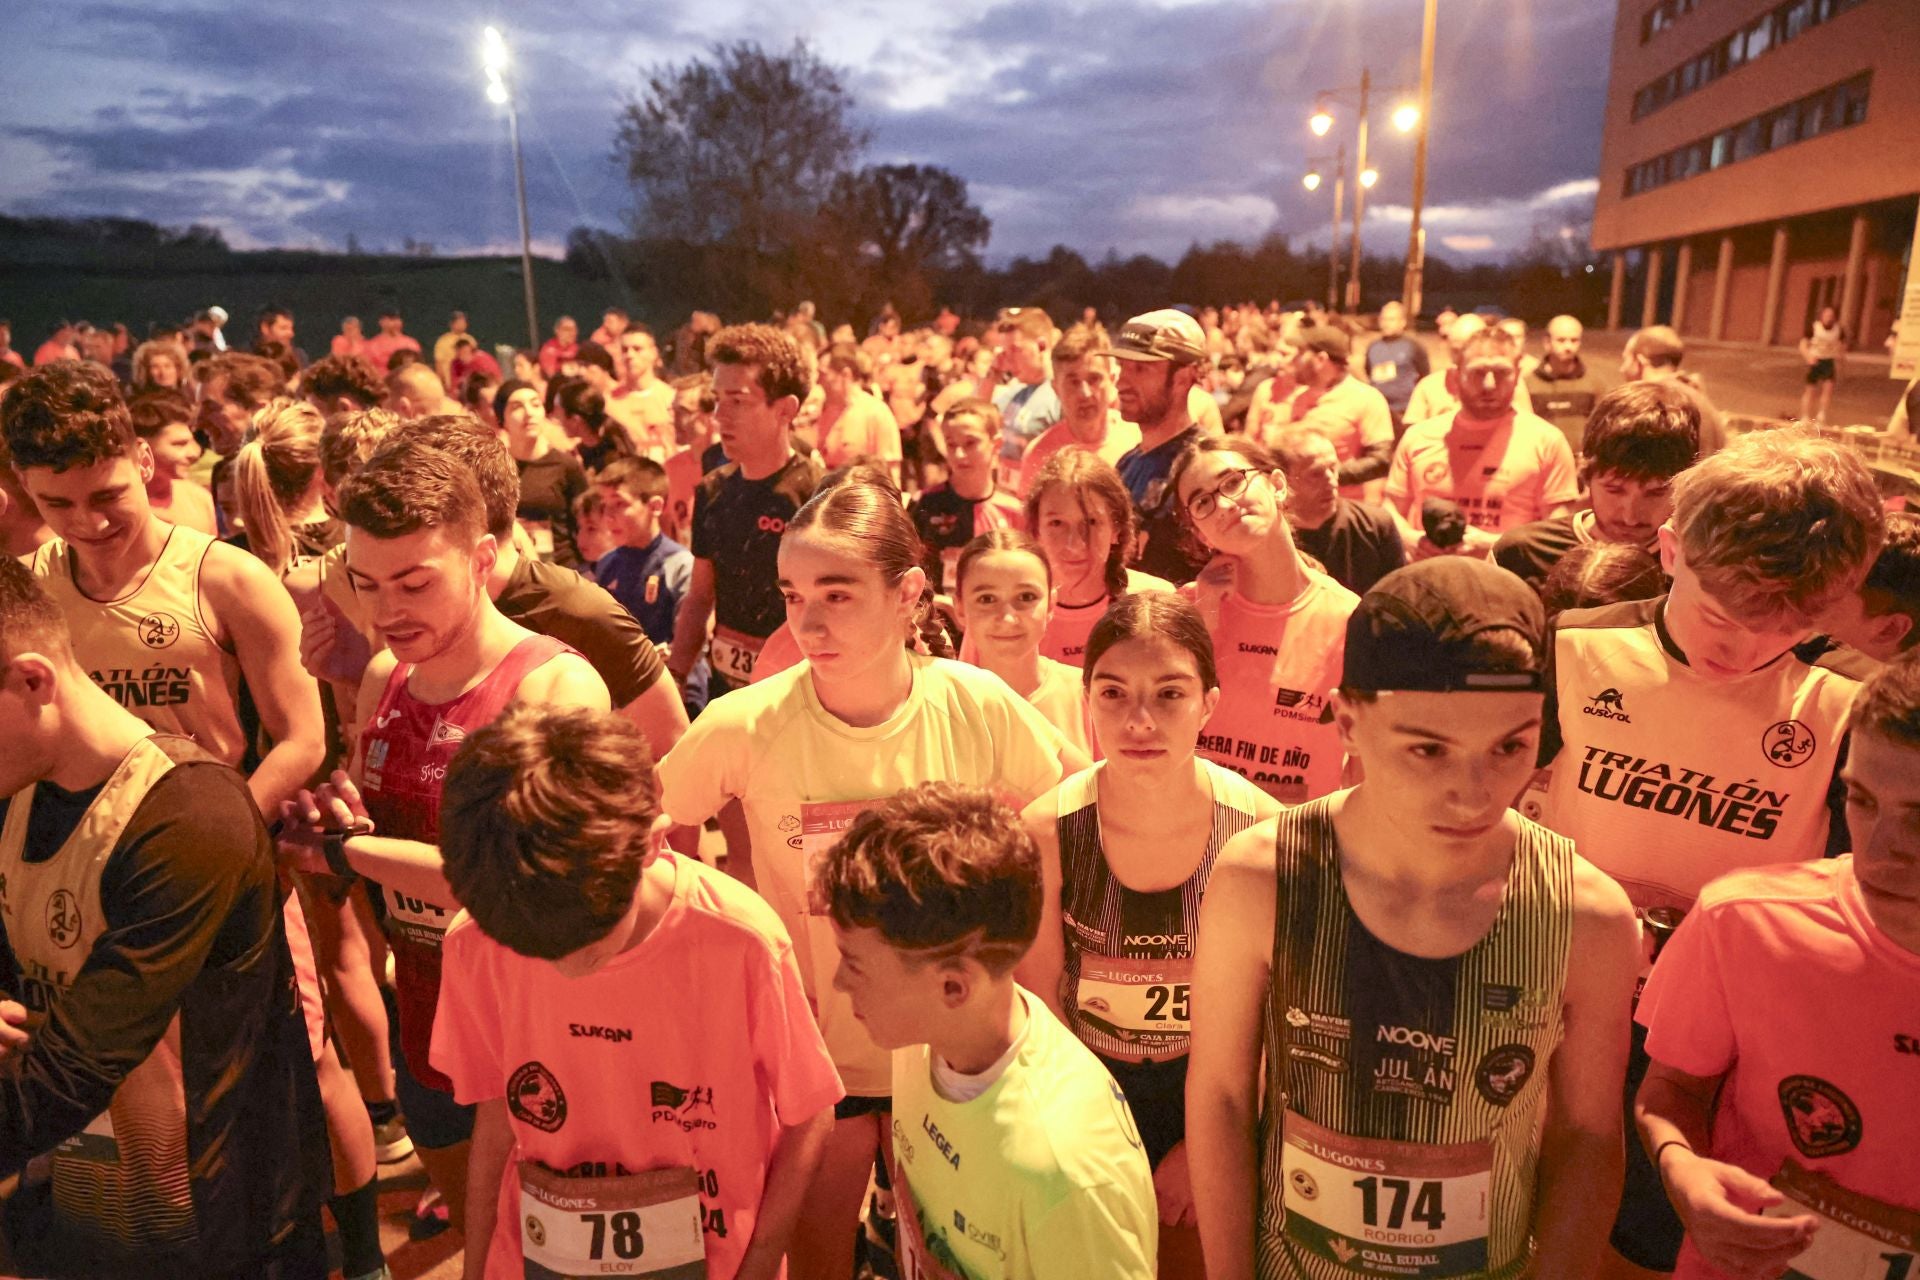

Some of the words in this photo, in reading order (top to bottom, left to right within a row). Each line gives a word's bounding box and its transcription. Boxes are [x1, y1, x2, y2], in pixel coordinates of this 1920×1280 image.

[730, 647, 760, 674] 23
[1238, 642, 1279, 656] SUKAN
[88, 662, 190, 682] ATLÓN
[102, 681, 190, 707] ONES
[1196, 731, 1232, 756] RERA
[1236, 740, 1256, 762] FIN
[1259, 745, 1279, 765] DE
[1282, 746, 1310, 770] AÑO
[1584, 745, 1790, 808] TRIATLÓN
[1577, 760, 1783, 840] LUGONES
[1123, 934, 1188, 946] NOONE
[1108, 970, 1164, 983] LUGONES
[568, 1023, 633, 1042] SUKAN
[1155, 1022, 1184, 1030] Clara
[1376, 1024, 1457, 1056] NOONE
[922, 1113, 961, 1171] LEGEA
[1313, 1144, 1386, 1172] LUGONES
[539, 1190, 598, 1209] LUGONES
[1353, 1176, 1446, 1230] 174
[580, 1211, 644, 1260] 78
[1363, 1228, 1436, 1244] RODRIGO
[1818, 1199, 1912, 1247] LUGONES
[600, 1262, 634, 1273] ELOY
[1361, 1249, 1394, 1264] CAJA
[1396, 1254, 1440, 1266] RURAL
